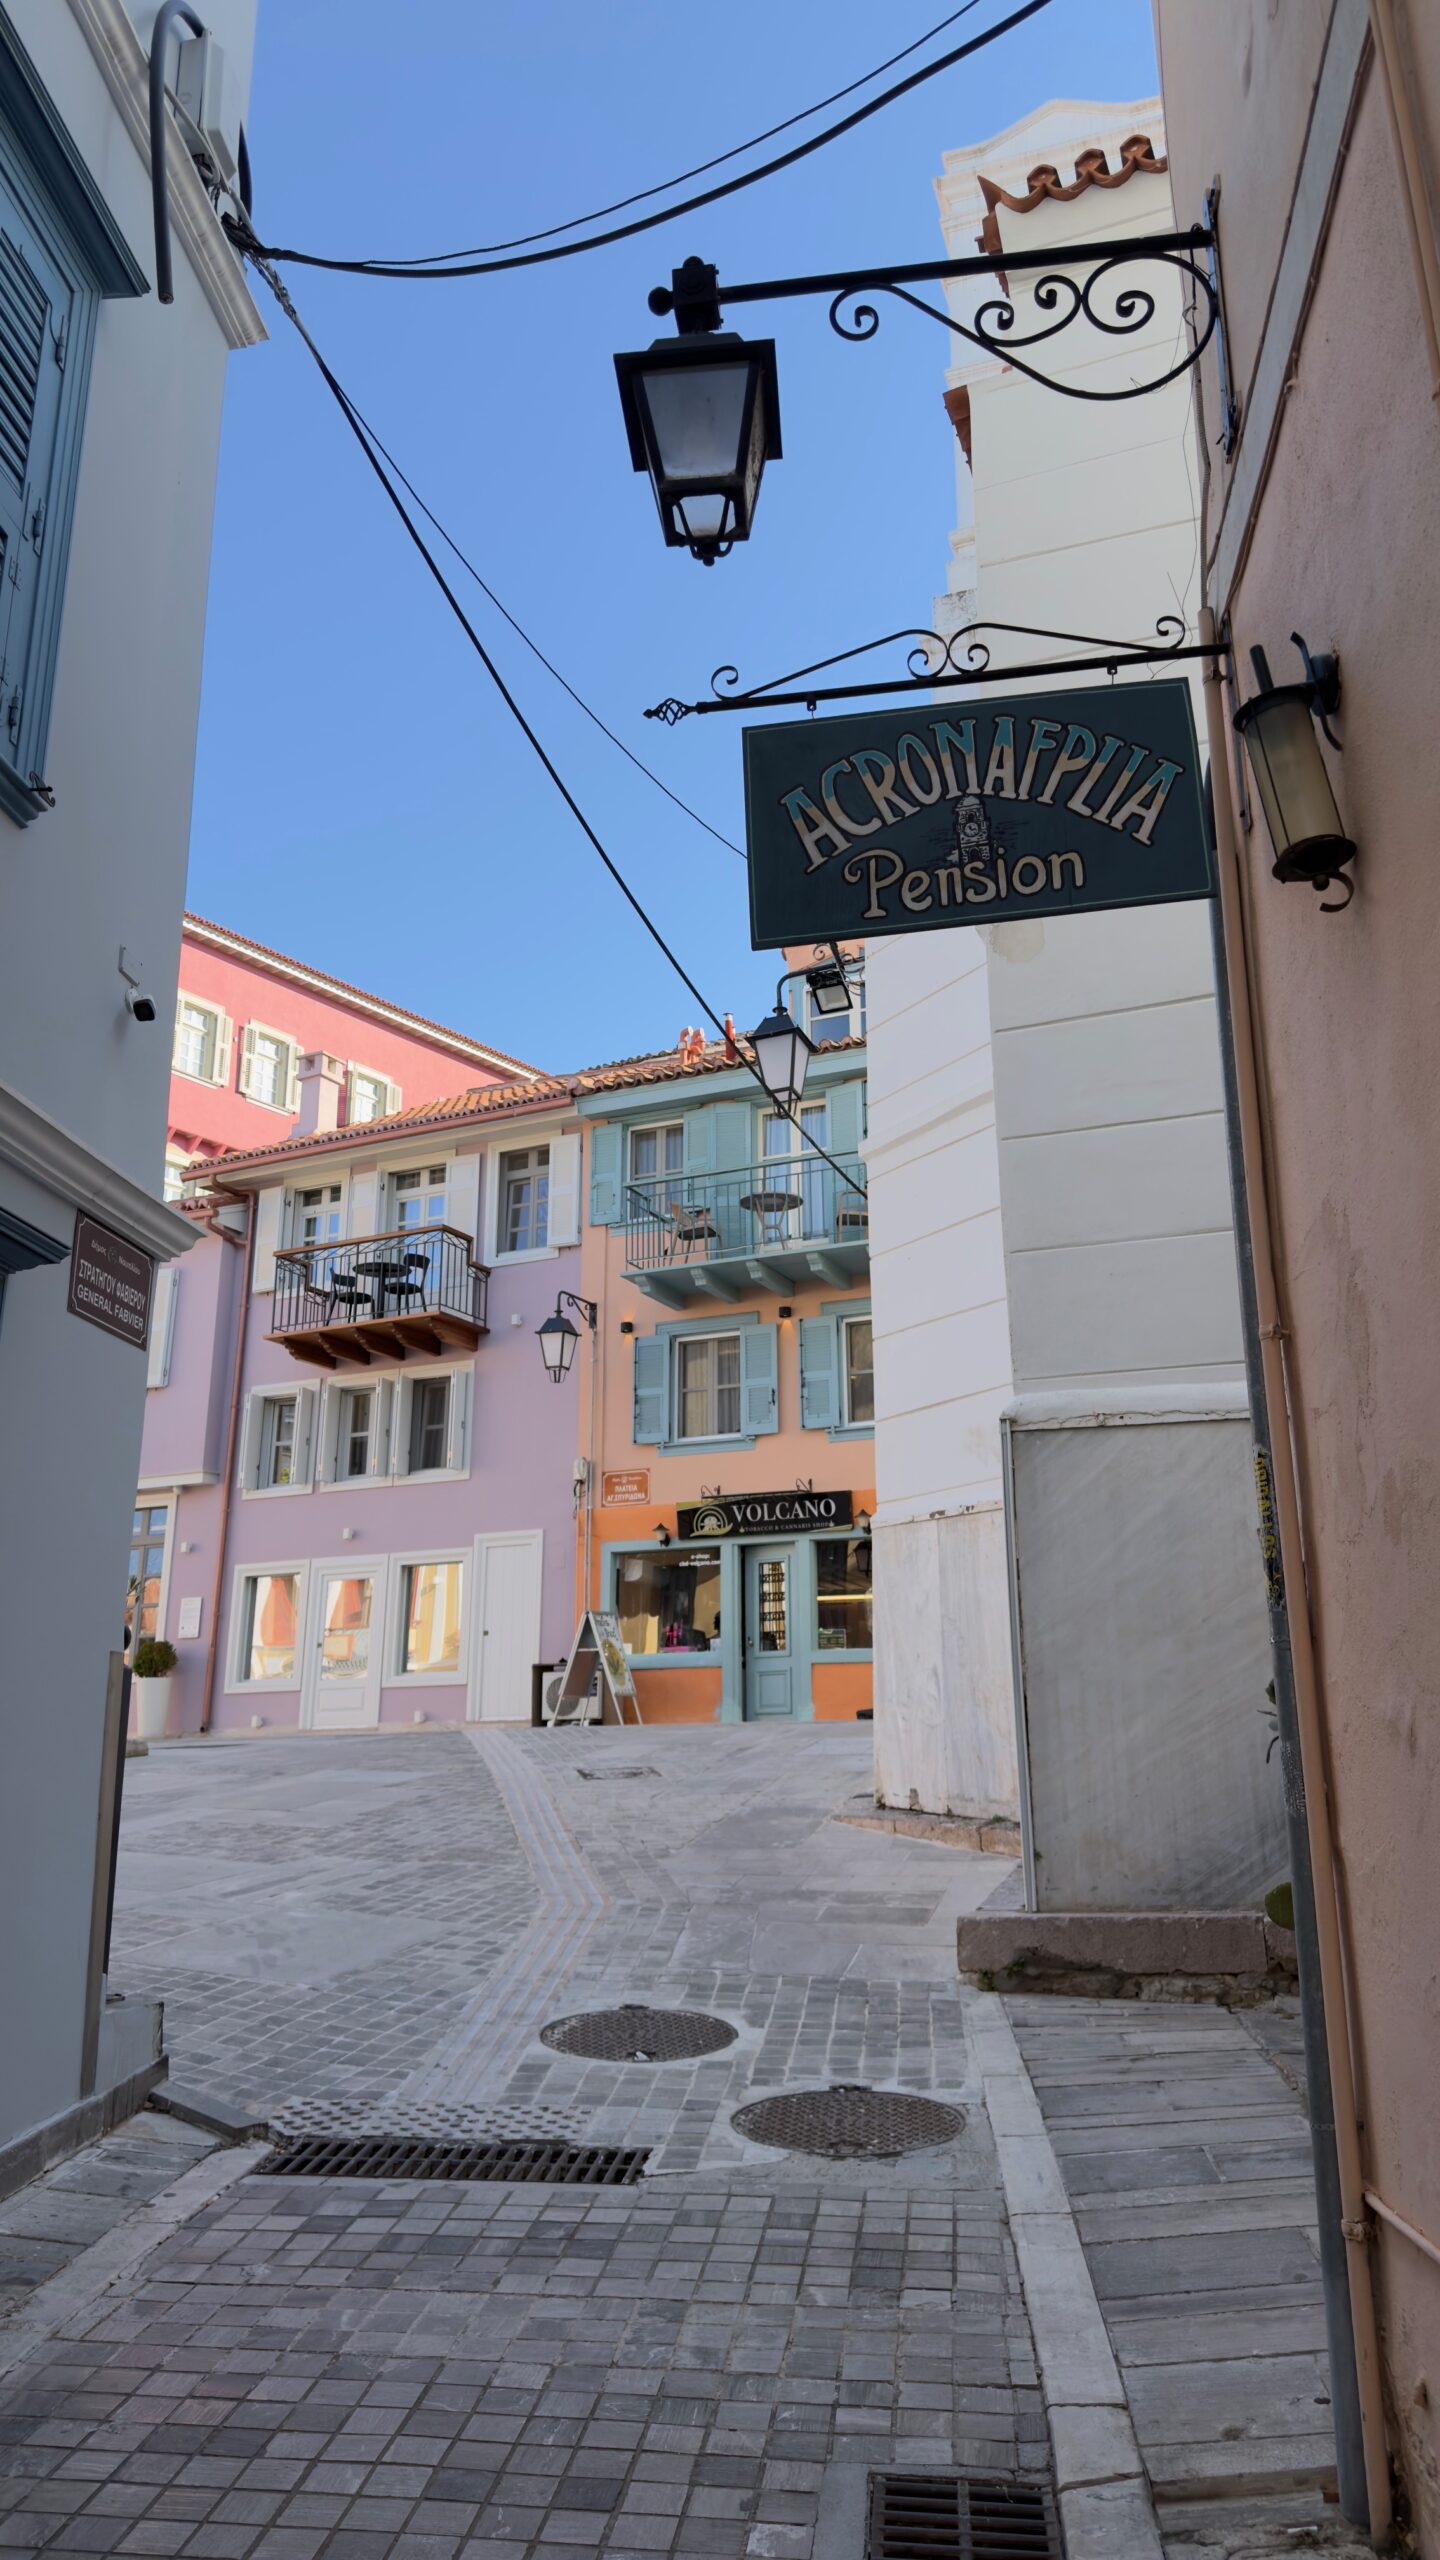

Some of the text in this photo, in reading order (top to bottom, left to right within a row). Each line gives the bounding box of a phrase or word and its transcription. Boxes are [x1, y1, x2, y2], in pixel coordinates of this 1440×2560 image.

[780, 714, 1184, 873] ACRONAFPLIA
[843, 846, 1084, 919] Pension
[77, 1284, 144, 1332] GENERAL FABVIER
[78, 1259, 147, 1313] ΣΤΡΑΤΗΓΟΥ ΦΑΒΙΕΡΟΥ
[732, 1498, 836, 1523] VOLCANO
[745, 1525, 774, 1533] TOBACCO
[781, 1522, 811, 1530] CANNABIS
